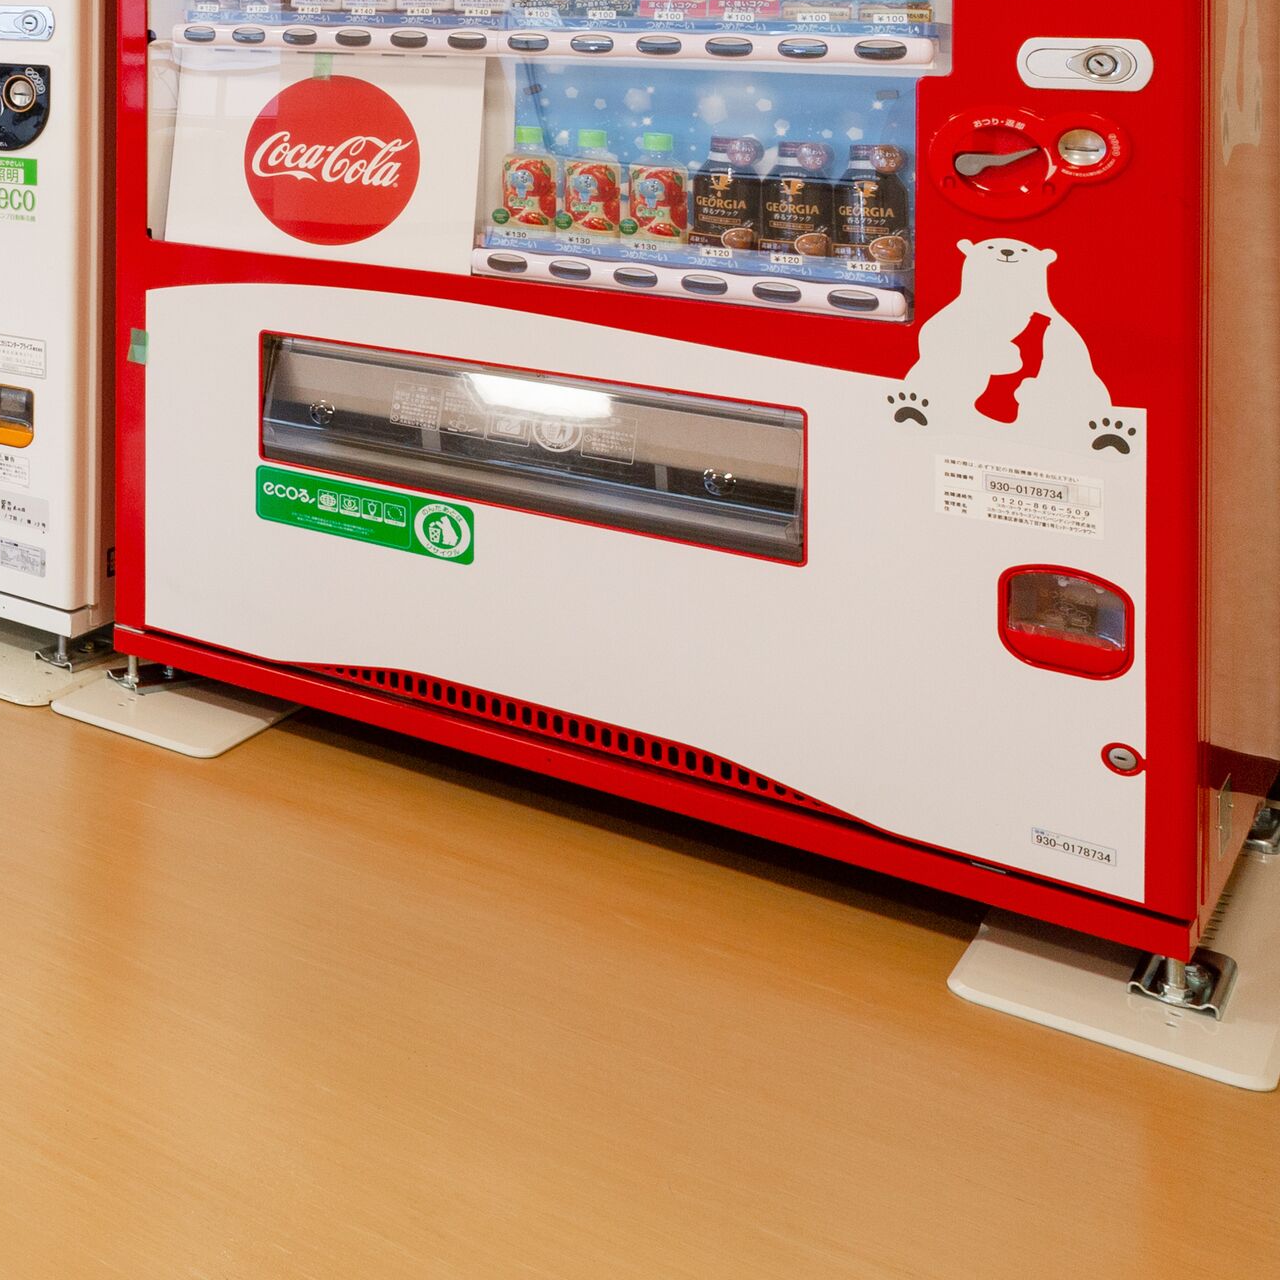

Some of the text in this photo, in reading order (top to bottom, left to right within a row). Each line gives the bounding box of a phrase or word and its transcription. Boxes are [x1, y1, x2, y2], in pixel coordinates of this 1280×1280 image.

[251, 130, 414, 188] Coca-Cola
[505, 231, 527, 239] ¥130
[568, 236, 590, 245] ¥130
[634, 242, 657, 251] ¥130
[704, 249, 730, 257] ¥120
[773, 255, 800, 264] ¥120
[850, 263, 877, 271] ¥120
[989, 481, 1063, 500] 930-0178734
[1035, 834, 1111, 863] 930-0178734
